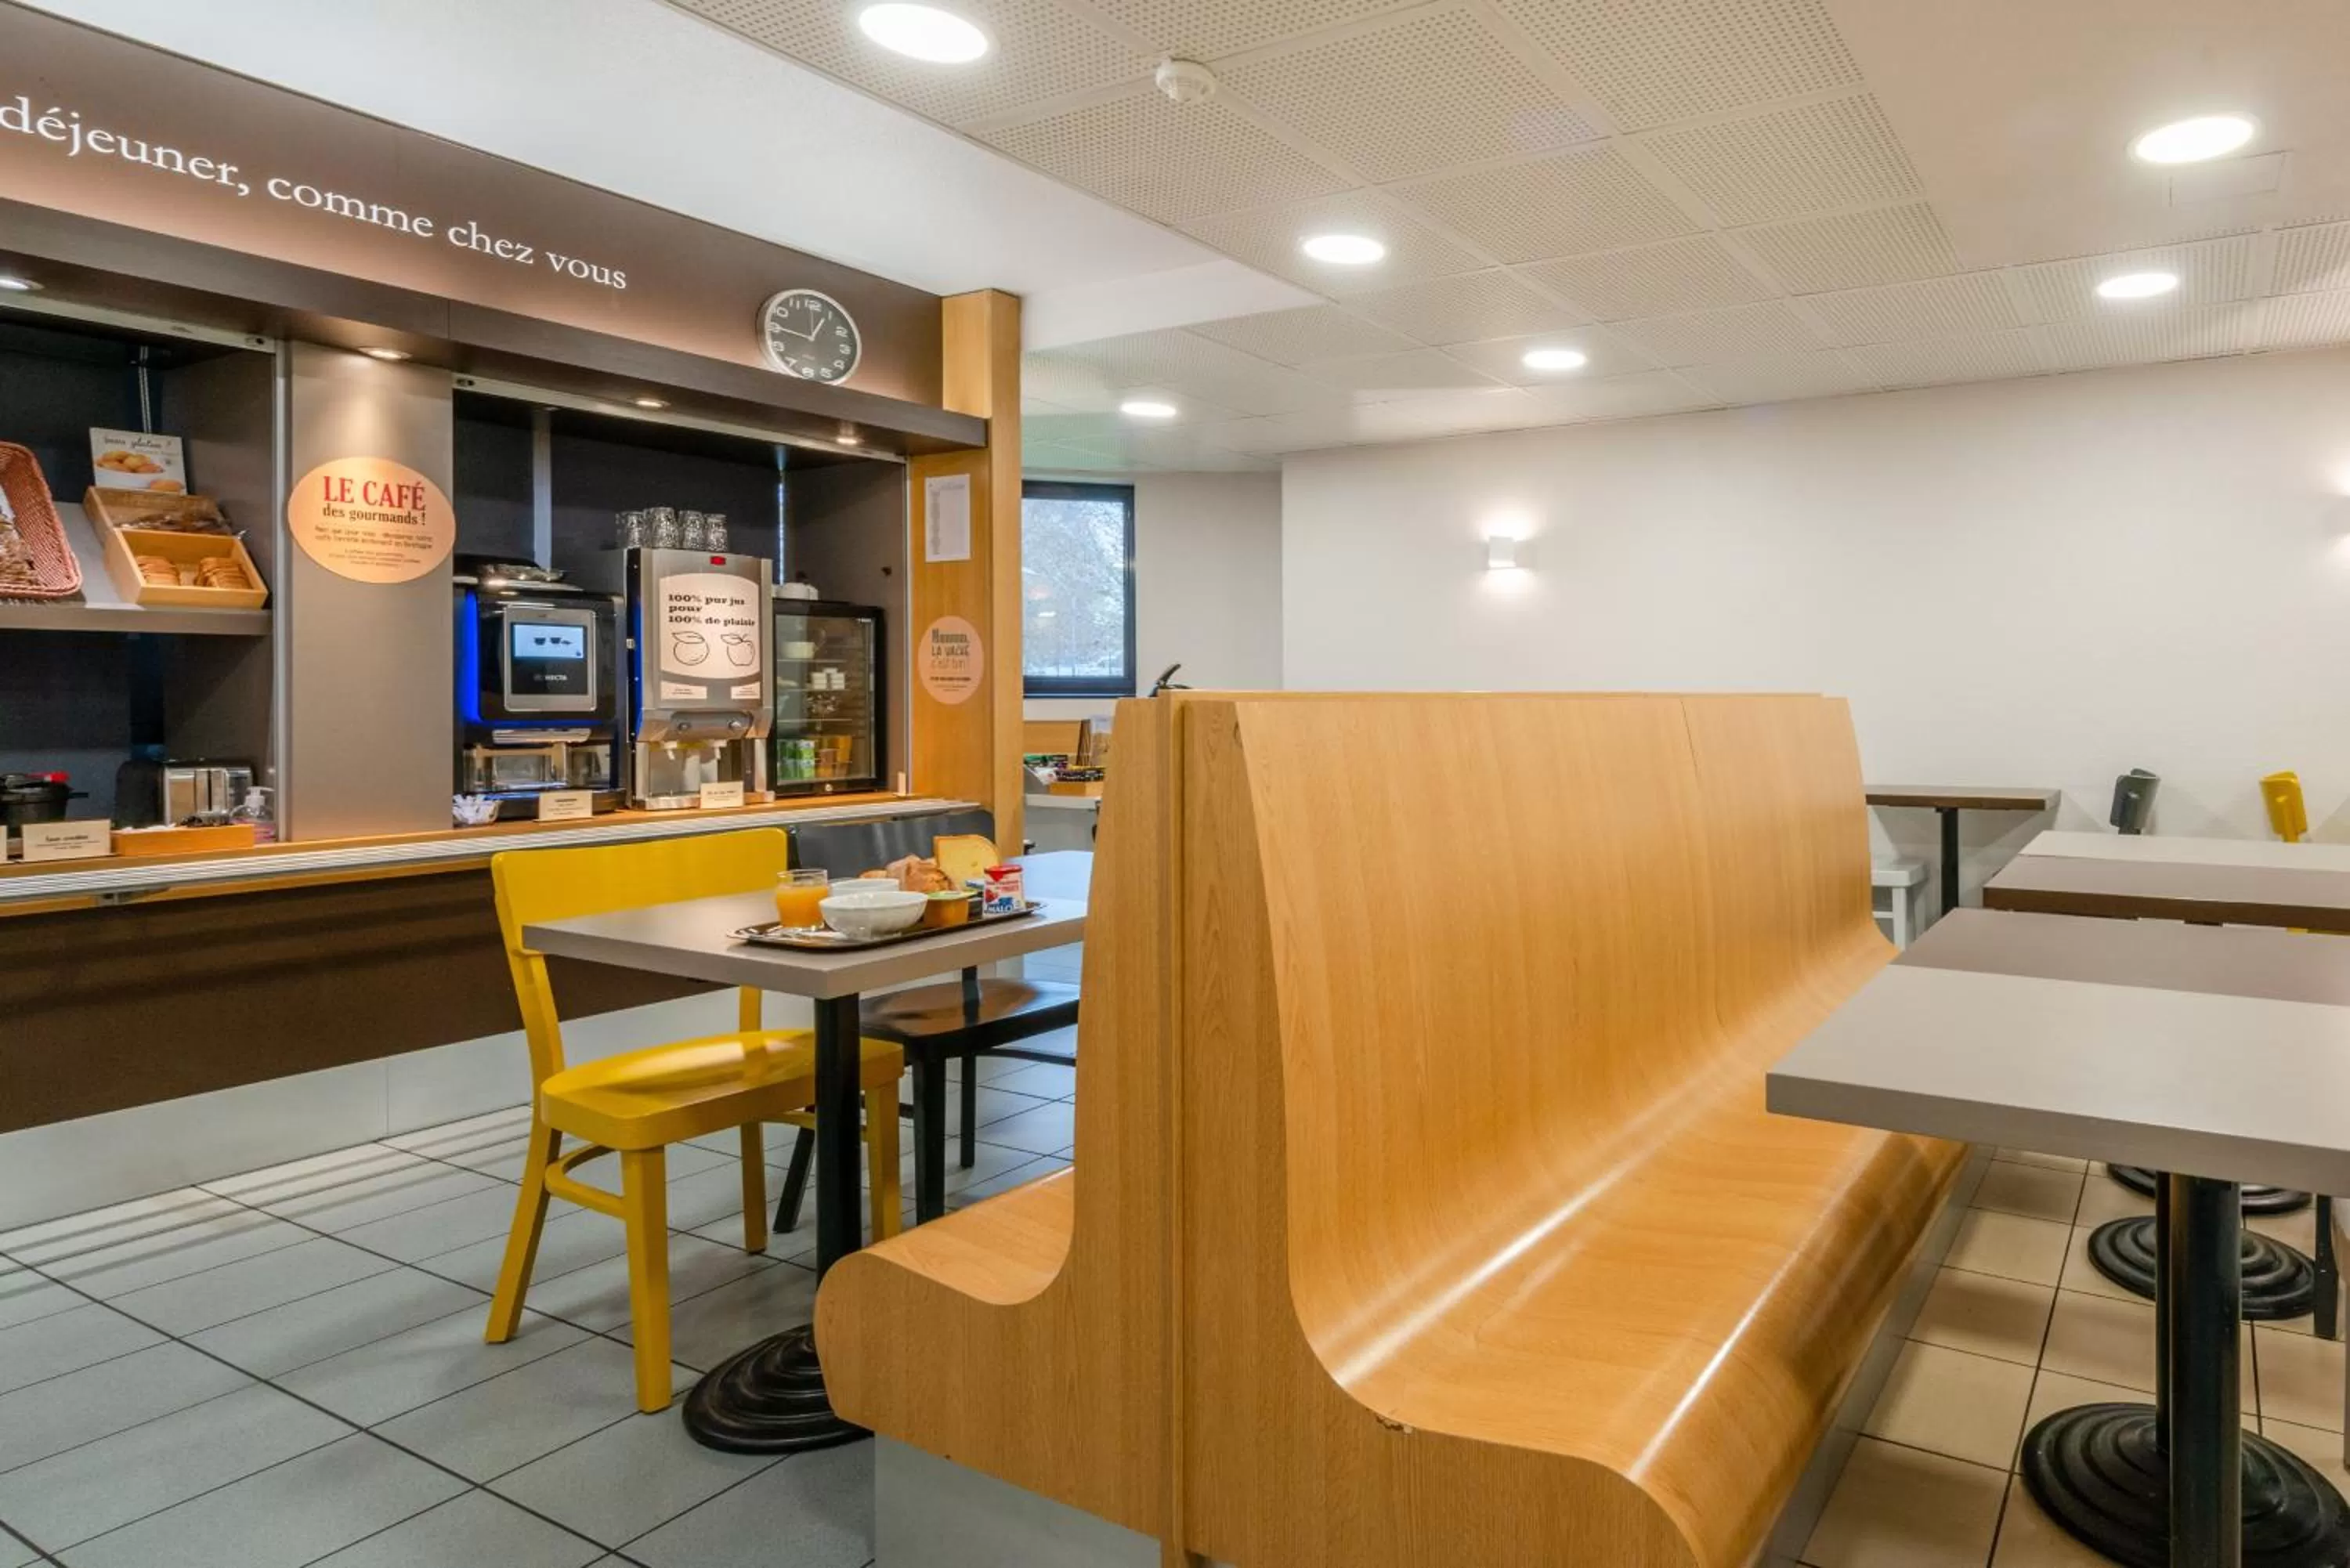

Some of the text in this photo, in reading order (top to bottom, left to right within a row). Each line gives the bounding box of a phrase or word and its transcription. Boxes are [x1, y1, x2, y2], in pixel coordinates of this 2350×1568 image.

[0, 95, 627, 290] déjeuner, comme chez vous
[323, 475, 426, 511] LE CAFÉ
[322, 503, 345, 518] des
[349, 509, 418, 526] gourmands
[668, 594, 745, 606] 100% pur jus
[723, 618, 755, 627] plaisir
